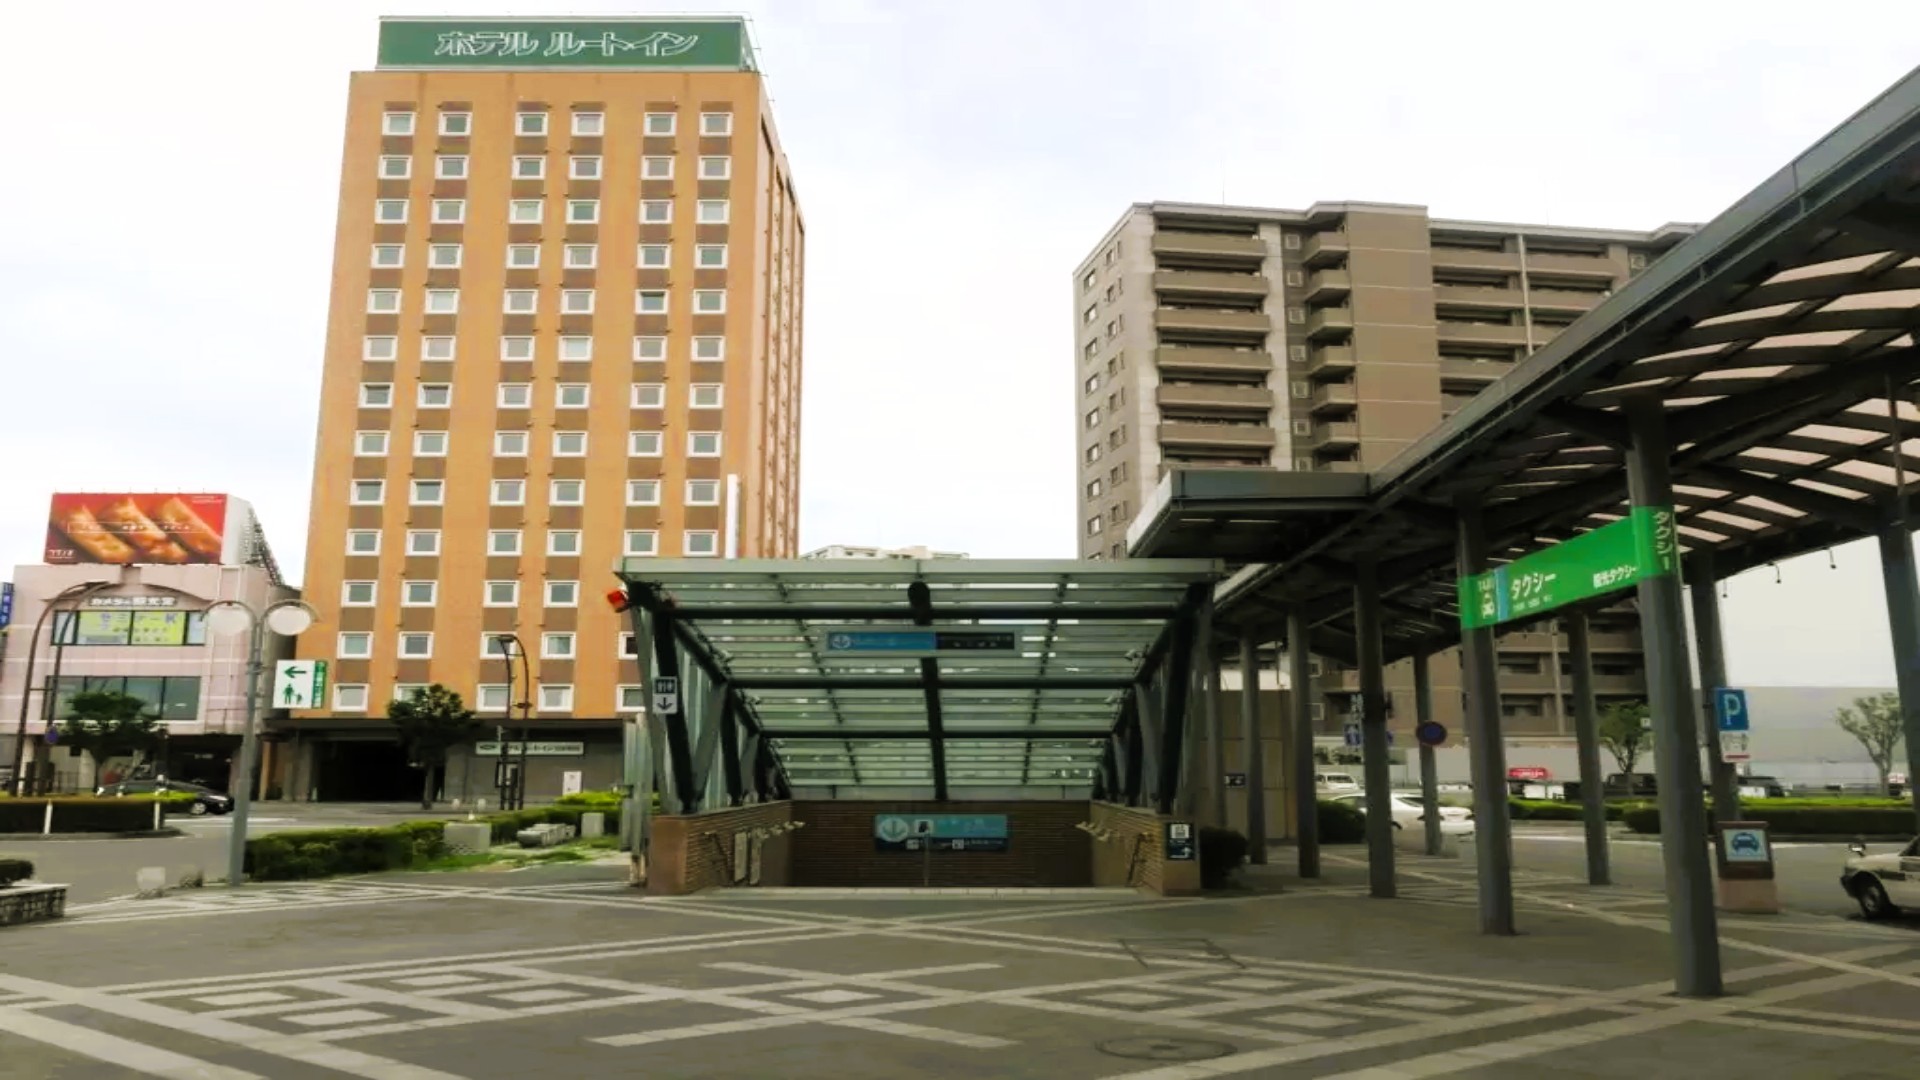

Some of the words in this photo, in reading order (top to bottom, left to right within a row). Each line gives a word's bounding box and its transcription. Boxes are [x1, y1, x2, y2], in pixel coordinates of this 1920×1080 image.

[435, 31, 539, 57] ホテル
[543, 31, 699, 57] ルートイン
[1653, 511, 1673, 570] タクシー
[1510, 572, 1556, 600] タクシー
[1723, 694, 1741, 725] P
